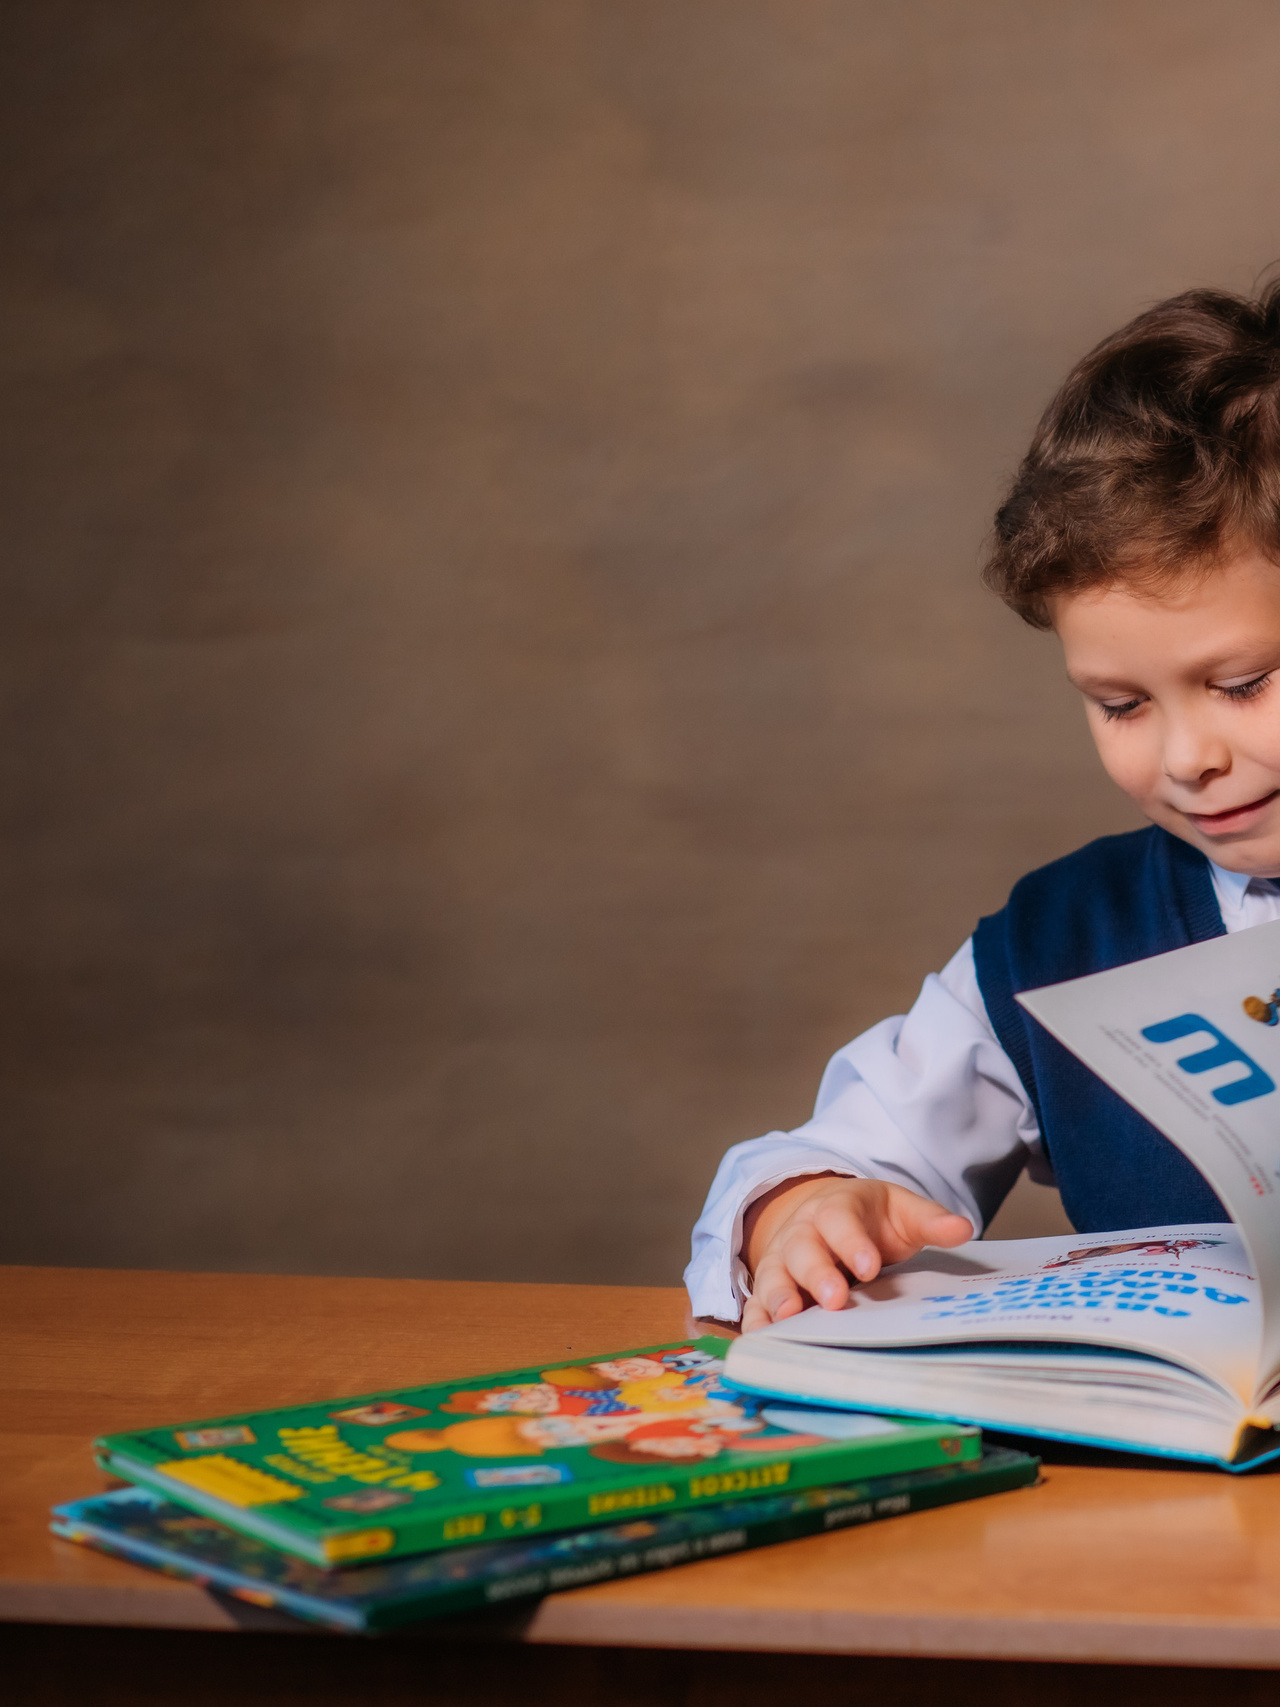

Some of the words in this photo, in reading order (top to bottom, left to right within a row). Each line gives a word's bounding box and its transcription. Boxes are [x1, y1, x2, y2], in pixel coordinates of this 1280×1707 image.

[1141, 1012, 1276, 1107] Ш
[690, 1461, 791, 1498] ДЕТСКОЕ
[587, 1482, 677, 1516] ЧТЕНИЕ
